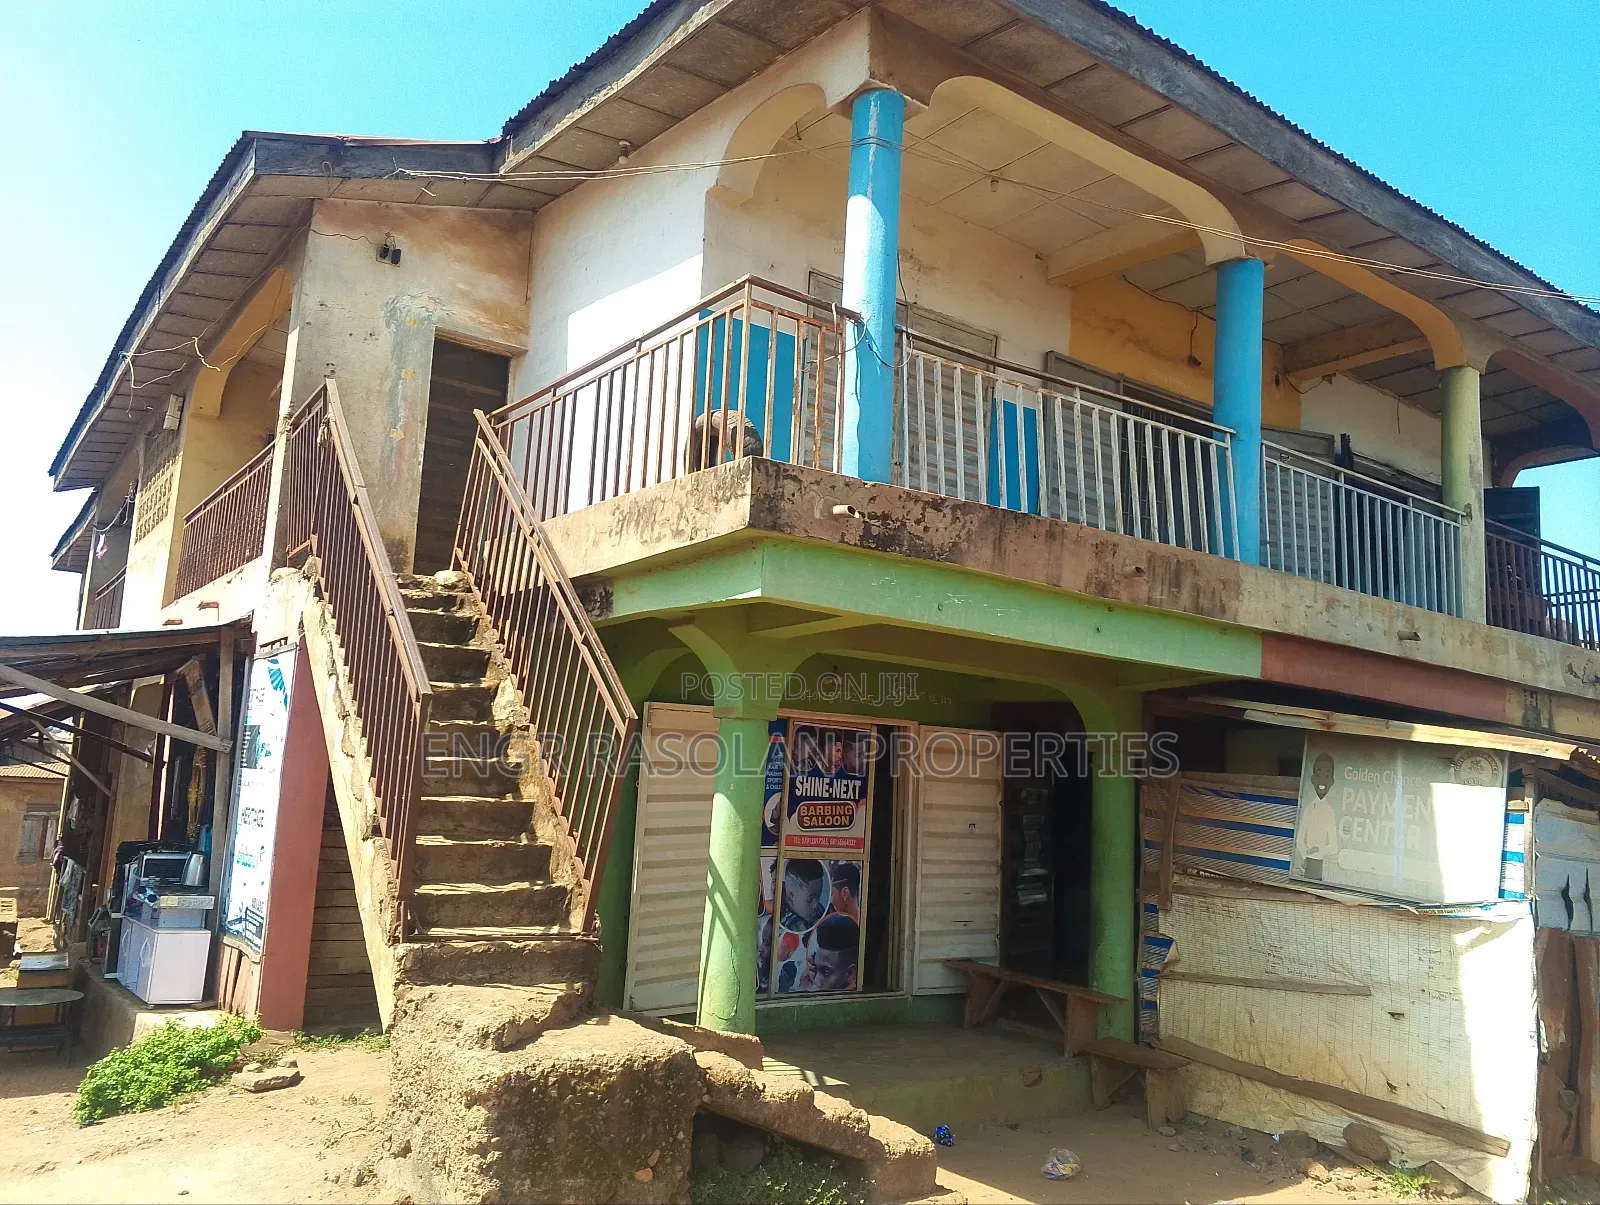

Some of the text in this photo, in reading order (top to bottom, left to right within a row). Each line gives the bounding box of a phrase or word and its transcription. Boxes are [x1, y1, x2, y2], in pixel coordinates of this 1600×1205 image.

[1344, 766, 1422, 787] Golden Chance
[795, 776, 862, 800] SHINE-NEXT
[800, 805, 853, 816] BARBING
[1340, 787, 1435, 822] PAYMEN
[803, 815, 850, 827] SALOON
[1338, 815, 1421, 849] CENTR
